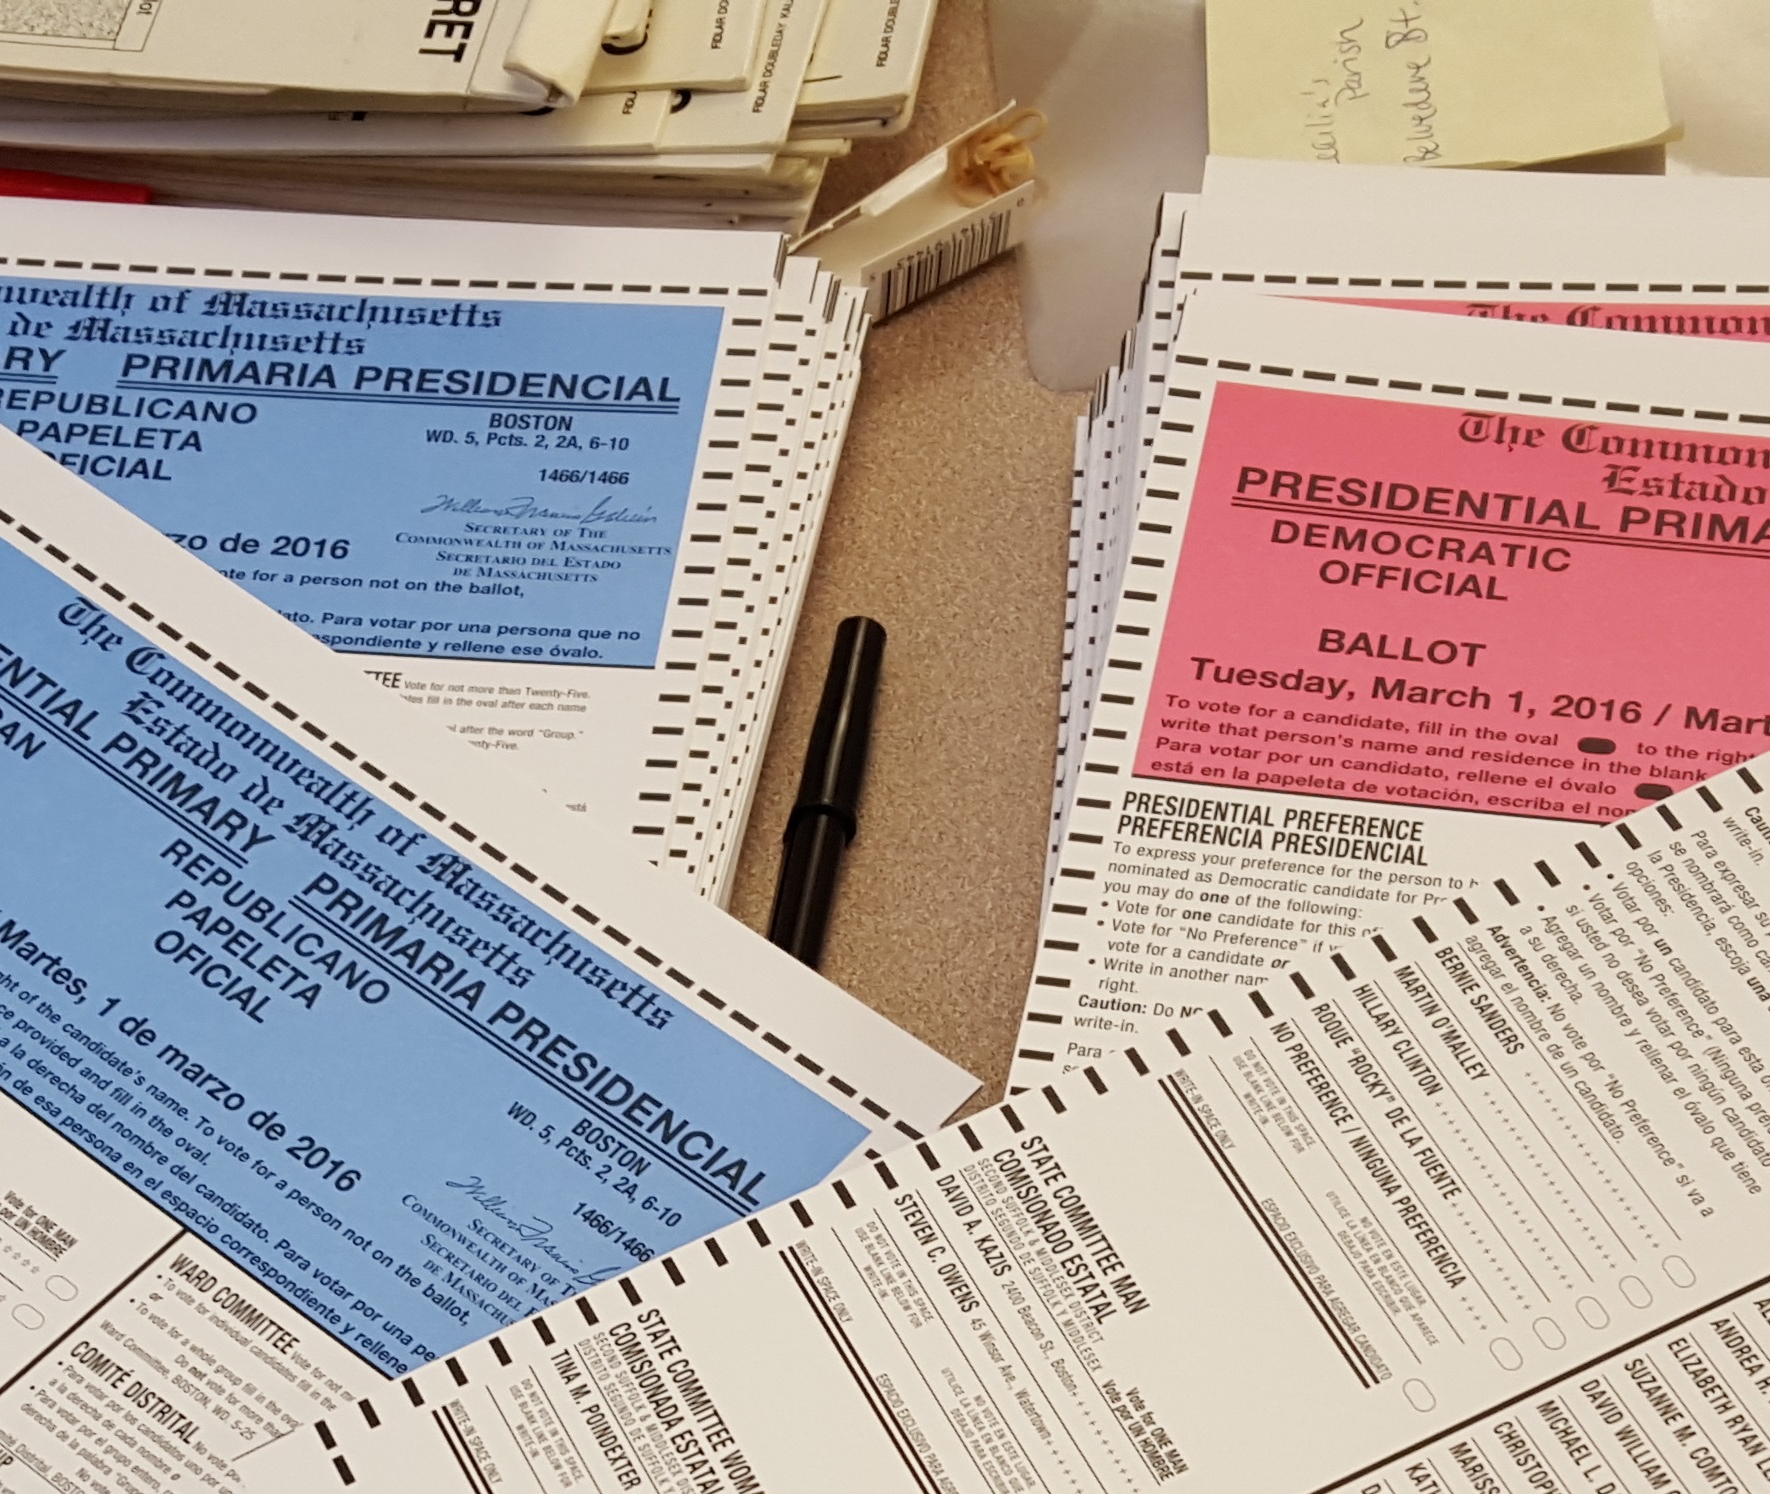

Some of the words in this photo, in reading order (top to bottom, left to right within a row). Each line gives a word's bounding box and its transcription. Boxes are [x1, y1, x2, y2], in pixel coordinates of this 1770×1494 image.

[762, 22, 786, 79] DOUBLEDAY
[7, 311, 54, 339] de
[64, 315, 365, 356] Massachusetts
[147, 288, 193, 314] of
[201, 289, 501, 329] Massachusetts
[121, 353, 337, 389] PRIMARIA
[353, 365, 681, 403] PRESIDENCIAL
[16, 419, 202, 453] PAPELETA
[426, 429, 458, 444] WD.
[464, 431, 480, 447] 5,
[486, 431, 528, 447] Pcts.
[533, 434, 549, 450] 2,
[554, 435, 583, 451] 2A,
[589, 436, 630, 451] 6-10
[488, 412, 574, 432] BOSTON
[1459, 411, 1546, 453] The
[41, 449, 172, 481] FICIAL
[539, 468, 630, 485] 1466/1466
[1602, 463, 1768, 506] Estado
[1236, 466, 1601, 531] PRESIDENTIAL
[219, 532, 260, 555] de
[270, 535, 350, 560] 2016
[1270, 518, 1571, 573] DEMOCRATIC
[1319, 559, 1508, 601] OFFICIAL
[1318, 628, 1487, 668] BALLOT
[1190, 656, 1355, 702] Tuesday,
[1371, 676, 1491, 710] March
[1508, 690, 1536, 719] 1,
[1550, 694, 1642, 724] 2016
[1653, 703, 1672, 727] /
[58, 596, 124, 652] The
[125, 646, 376, 826] Commonwealth
[375, 824, 428, 857] of
[415, 852, 675, 1031] Massachusetts
[100, 730, 277, 851] PRIMARY
[1122, 790, 1275, 828] PRESIDENTIAL
[1282, 808, 1424, 842] PREFERENCE
[124, 690, 239, 784] Estado
[239, 774, 285, 816] de
[281, 812, 536, 989] Massachusetts
[1117, 814, 1263, 850] PREFERENCIA
[1271, 830, 1428, 867] PRESIDENCIAL
[160, 838, 390, 1004] REPUBLICANO
[165, 889, 322, 1010] PAPELETA
[154, 930, 272, 1024] OFICIAL
[1436, 947, 1475, 995] BERNIE
[1470, 993, 1520, 1055] SANDERS
[301, 871, 487, 1012] PRIMARIA
[486, 999, 767, 1207] PRESIDENCIAL
[1354, 985, 1399, 1038] HILLARY
[1393, 1040, 1441, 1096] CLINTON
[1397, 966, 1435, 1018] MARTIN
[1433, 1015, 1490, 1080] O'MALLEY
